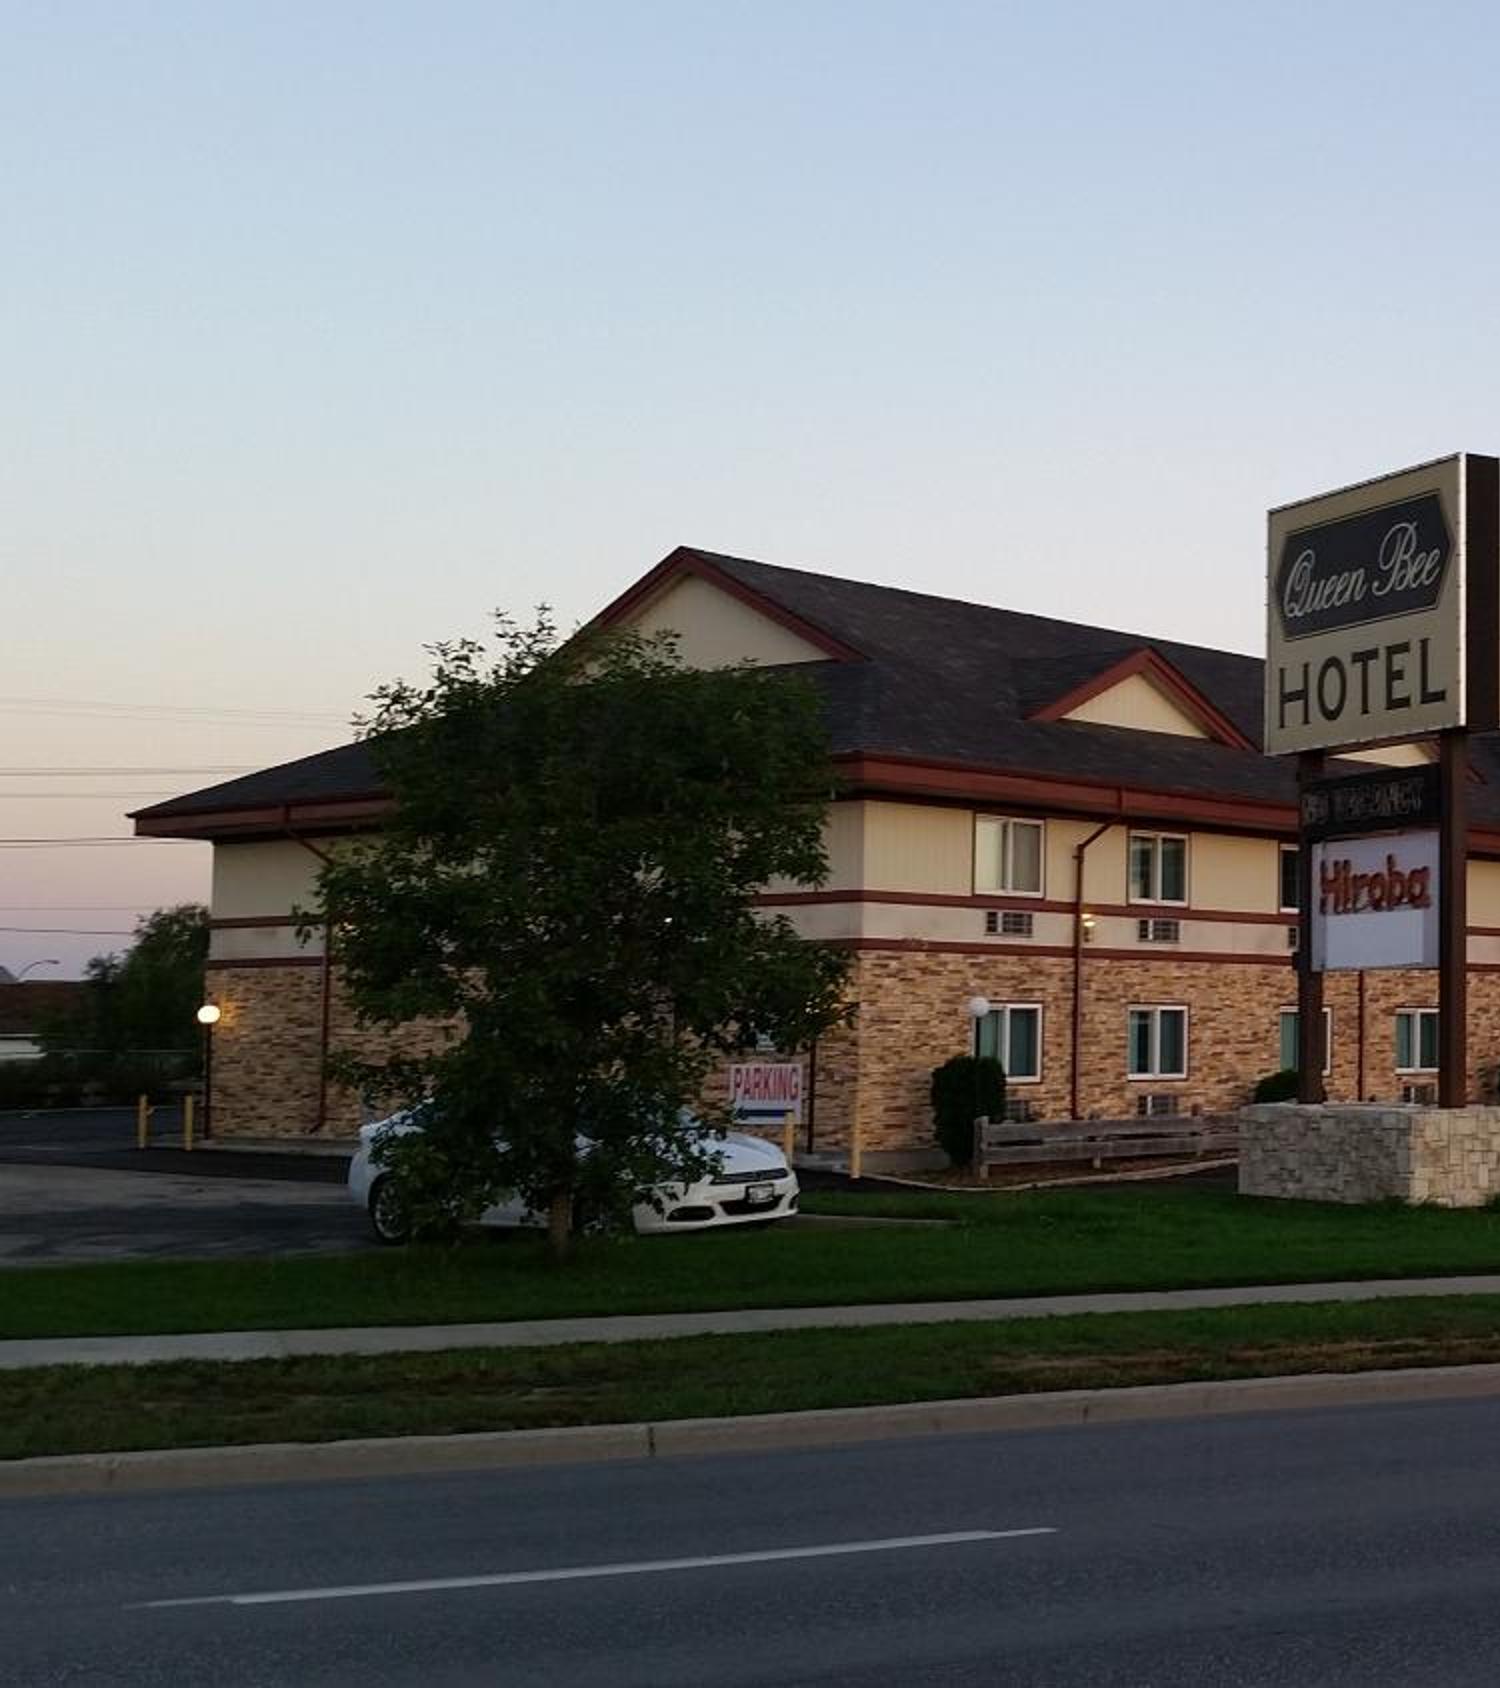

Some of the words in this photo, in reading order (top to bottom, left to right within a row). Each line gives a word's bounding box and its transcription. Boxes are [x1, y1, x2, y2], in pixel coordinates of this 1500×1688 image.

[1284, 550, 1367, 618] Queen
[1371, 521, 1441, 596] Bee
[1278, 638, 1446, 729] HOTEL
[735, 1066, 799, 1100] PARKING
